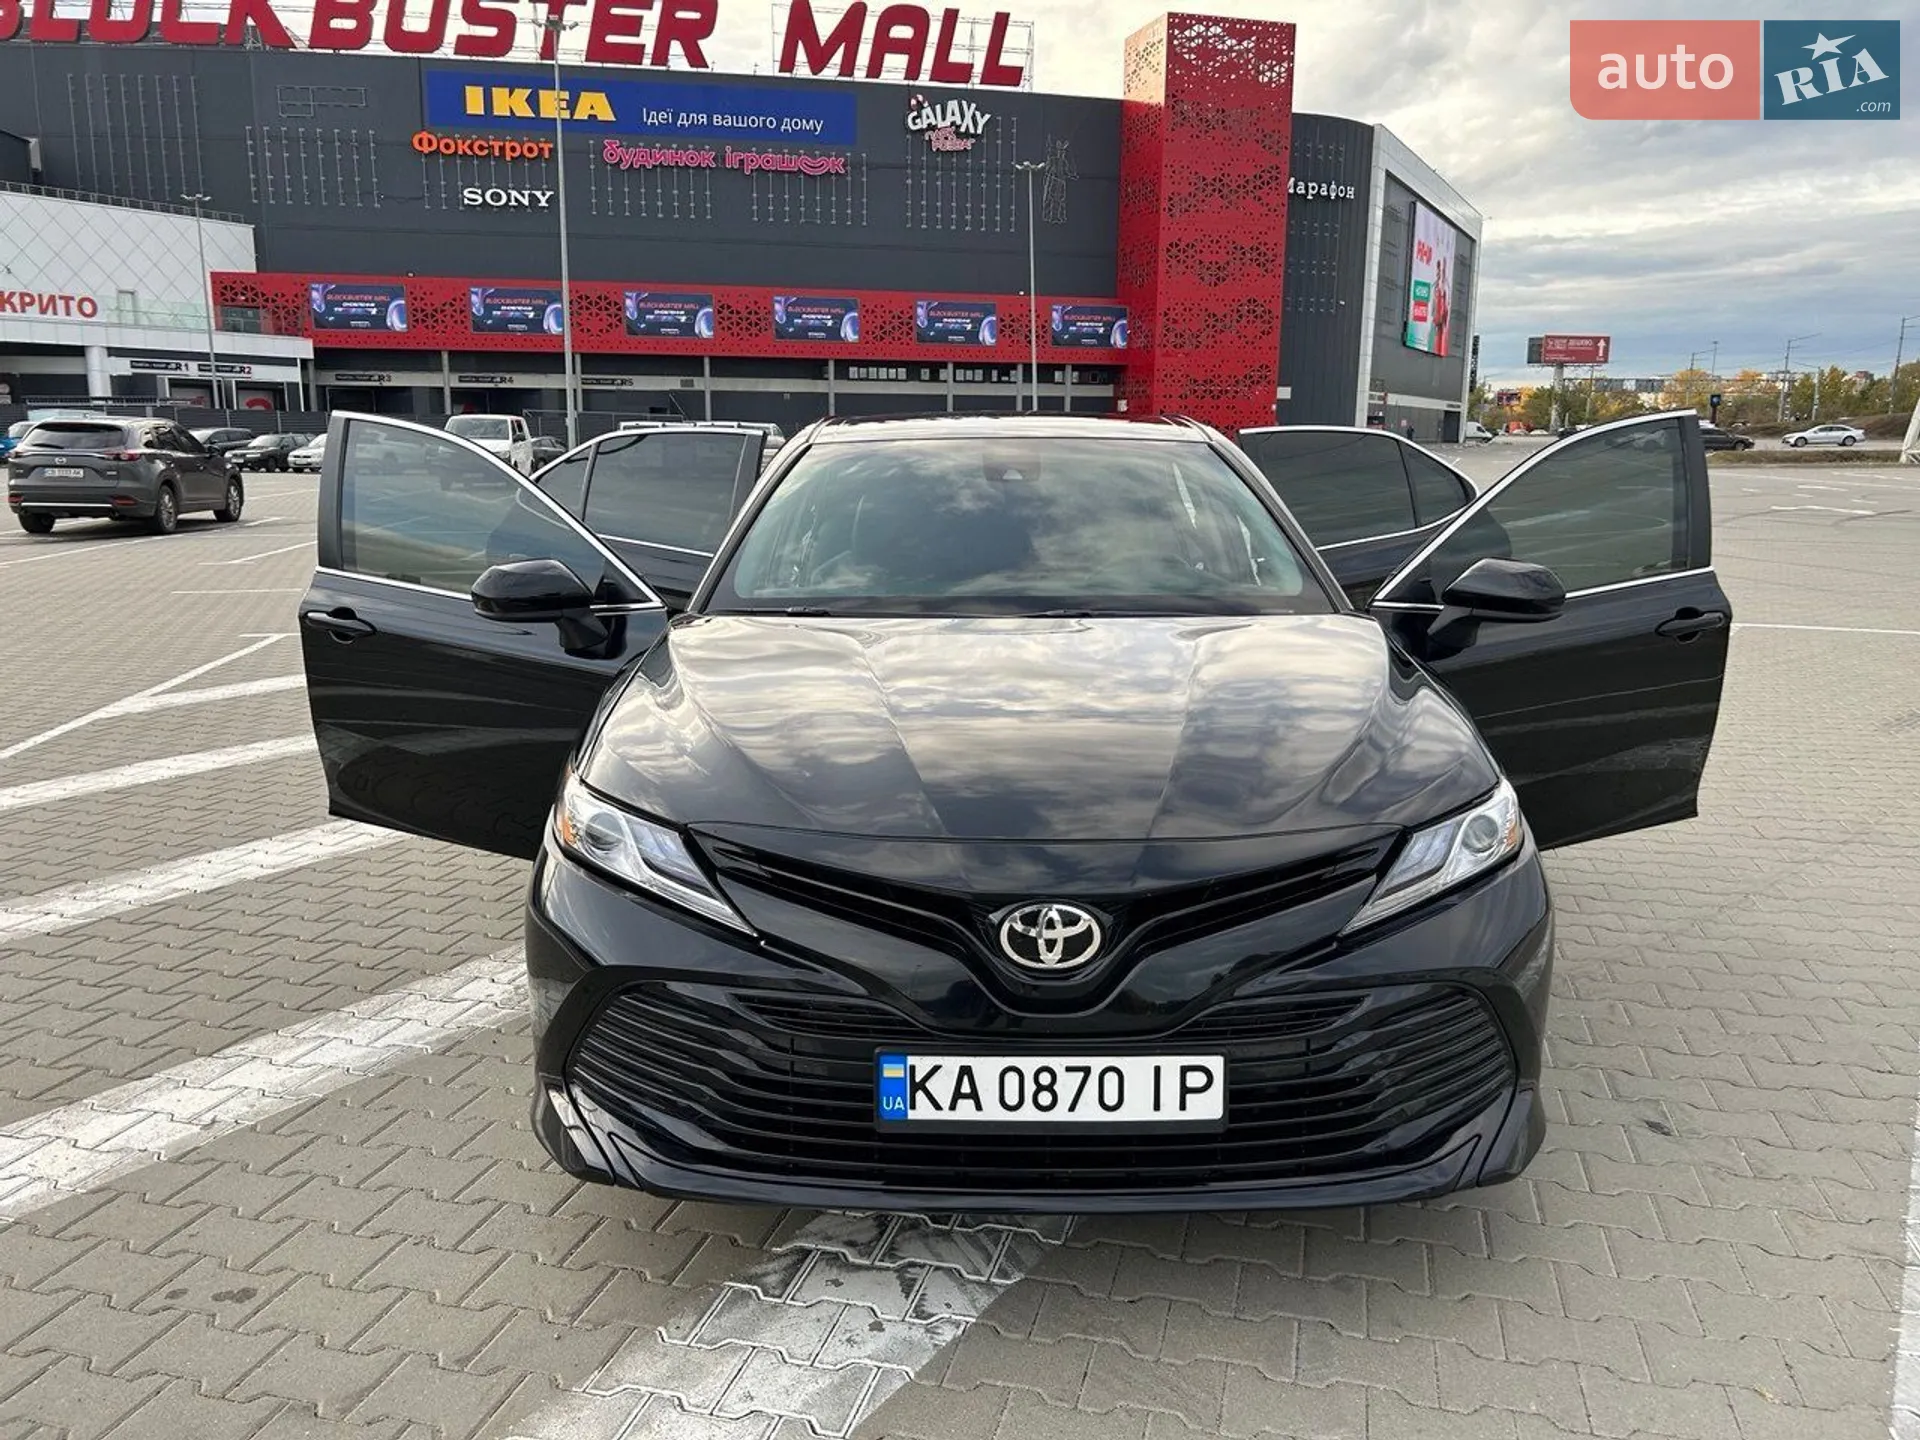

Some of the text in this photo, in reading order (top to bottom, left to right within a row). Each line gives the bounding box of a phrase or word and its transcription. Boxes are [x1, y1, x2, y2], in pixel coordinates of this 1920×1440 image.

[0, 0, 1024, 87] LOCKBUSTER MALL
[464, 85, 617, 122] IKEA
[907, 99, 992, 135] GALAXY
[643, 108, 824, 135] Ідеї для вашого дому
[411, 131, 553, 161] Фокстрот
[603, 139, 846, 175] будинок іграшок
[463, 187, 554, 207] SONY
[0, 291, 98, 318] КРИТО
[883, 1096, 905, 1110] UA
[909, 1065, 1215, 1112] KA 0870 IP
